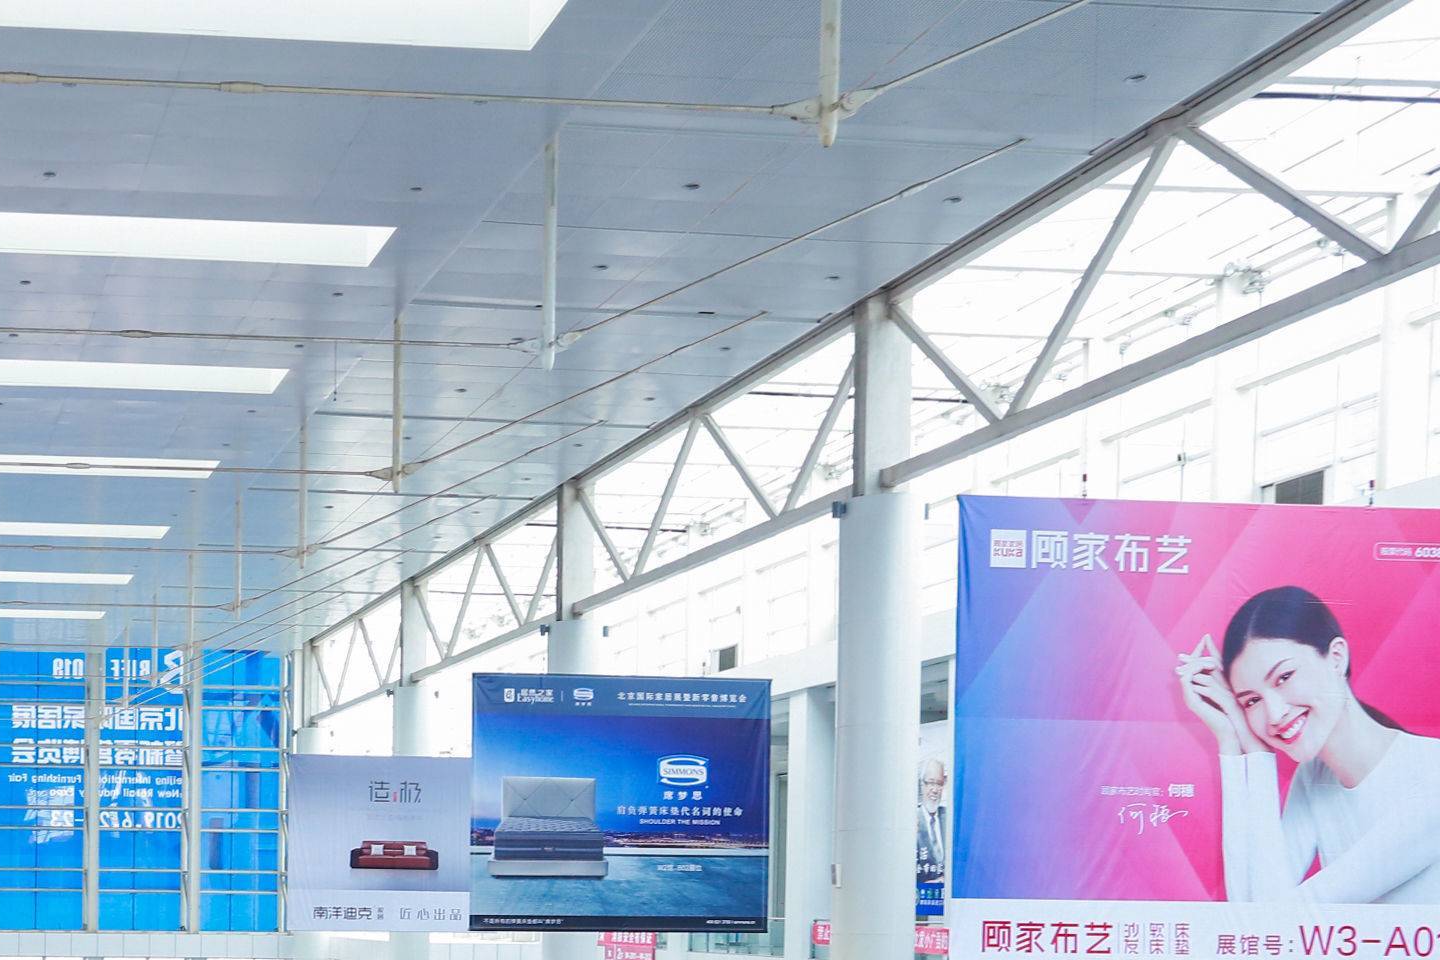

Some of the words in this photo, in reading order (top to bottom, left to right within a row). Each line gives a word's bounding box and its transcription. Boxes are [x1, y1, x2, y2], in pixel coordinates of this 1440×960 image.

[1031, 530, 1192, 574] 顾家布艺
[663, 768, 705, 776] SIMMONS
[313, 906, 372, 920] 南洋迪克
[400, 907, 462, 920] 匠心出品
[981, 920, 1113, 954] 顾家布艺
